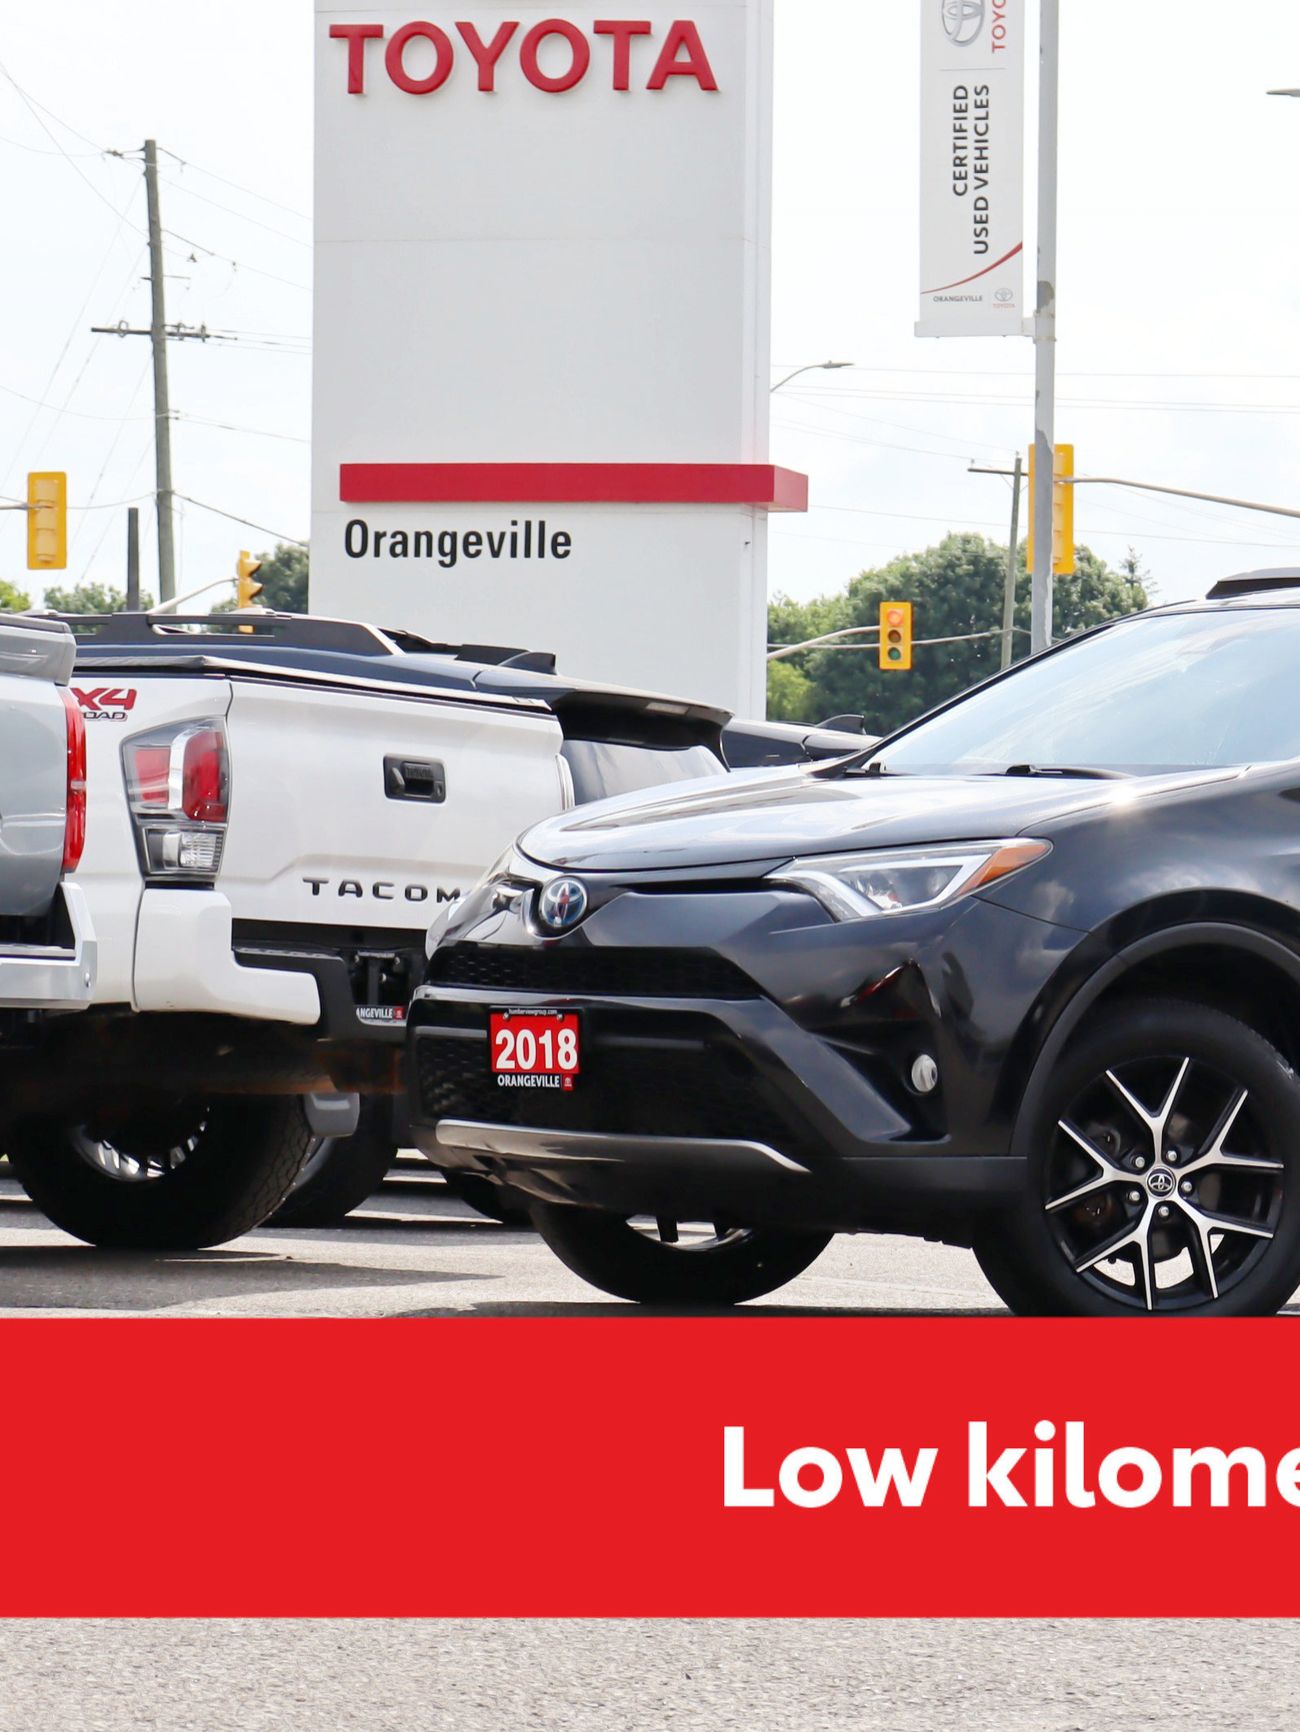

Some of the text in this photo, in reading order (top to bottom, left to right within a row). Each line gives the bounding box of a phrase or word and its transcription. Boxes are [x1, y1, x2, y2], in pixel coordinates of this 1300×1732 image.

[330, 19, 718, 95] TOYOTA
[952, 85, 968, 197] CERTIFIED
[973, 84, 990, 255] USED VEHICLES
[345, 519, 572, 569] Orangeville
[302, 877, 461, 904] TACOM
[495, 1028, 578, 1070] 2018
[497, 1074, 560, 1088] ORANGEVILLE
